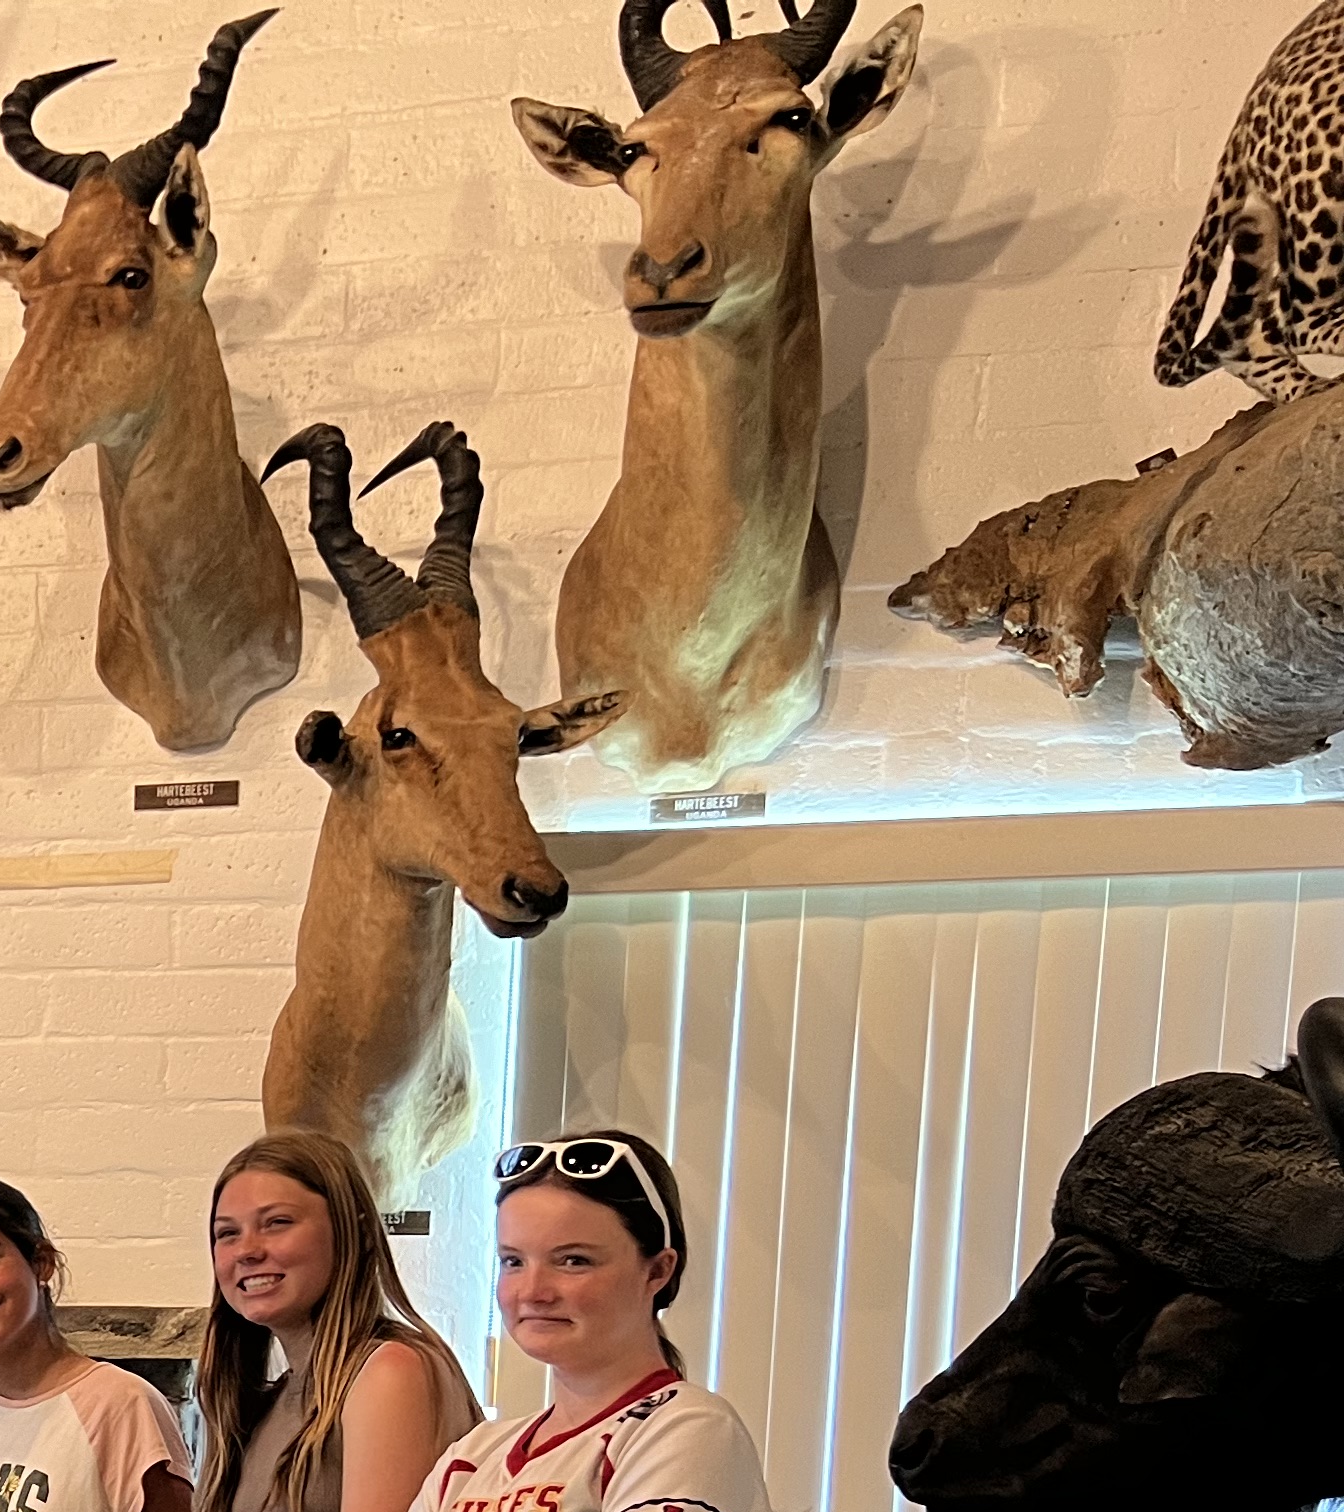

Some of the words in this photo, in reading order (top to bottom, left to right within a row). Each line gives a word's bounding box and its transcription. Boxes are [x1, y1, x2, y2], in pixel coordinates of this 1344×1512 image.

[156, 783, 215, 798] HARTEBEEST
[166, 797, 204, 806] UGANDA
[674, 795, 739, 811] HARTEBEEST
